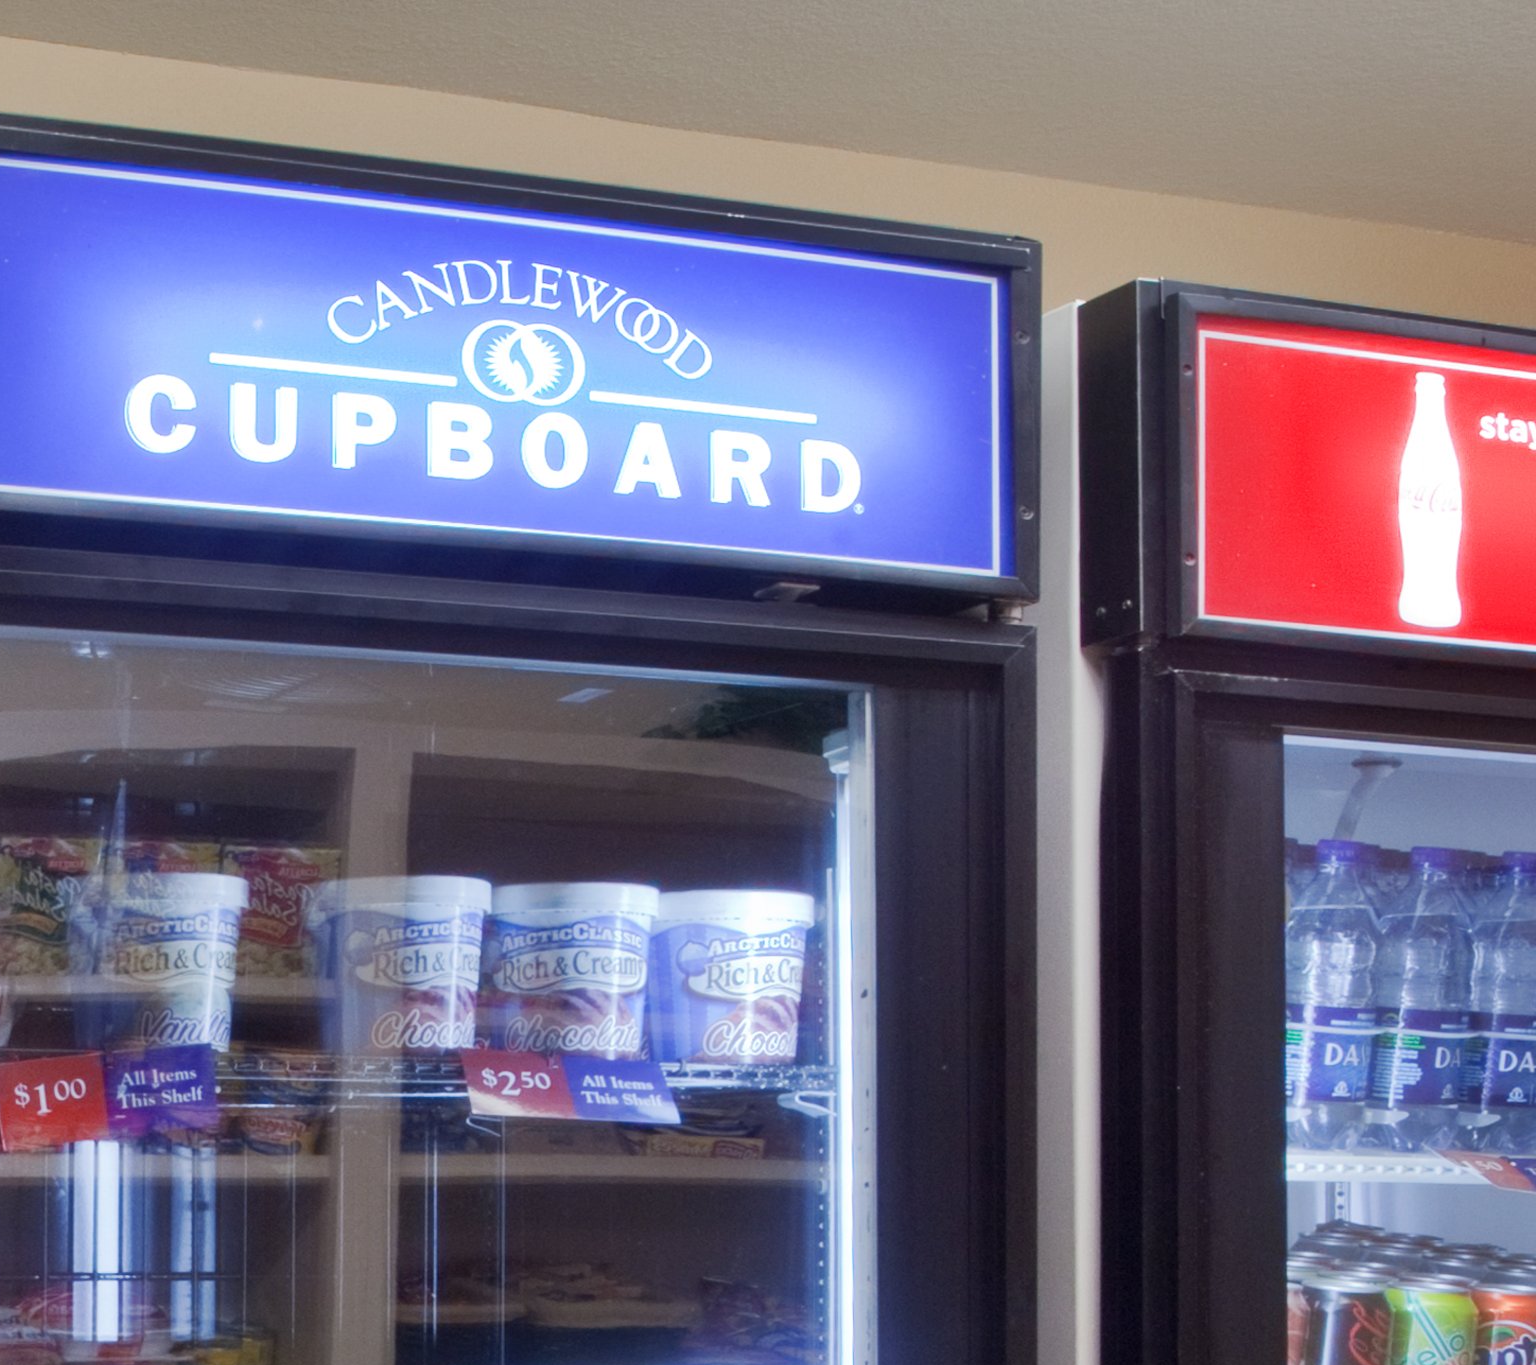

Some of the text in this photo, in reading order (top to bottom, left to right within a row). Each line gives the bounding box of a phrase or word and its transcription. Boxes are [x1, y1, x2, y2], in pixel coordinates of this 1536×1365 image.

[326, 258, 713, 380] CANDLEWOOD
[124, 373, 862, 515] CUPBOARD
[372, 949, 447, 981] Rich &
[502, 952, 645, 984] Rich & Creamy
[706, 961, 780, 988] Rich &
[505, 1017, 640, 1052] Chocolate
[122, 1066, 197, 1087] All Items
[582, 1075, 654, 1090] All Items
[119, 1086, 203, 1111] This Shelf
[581, 1090, 661, 1107] This Shelf
